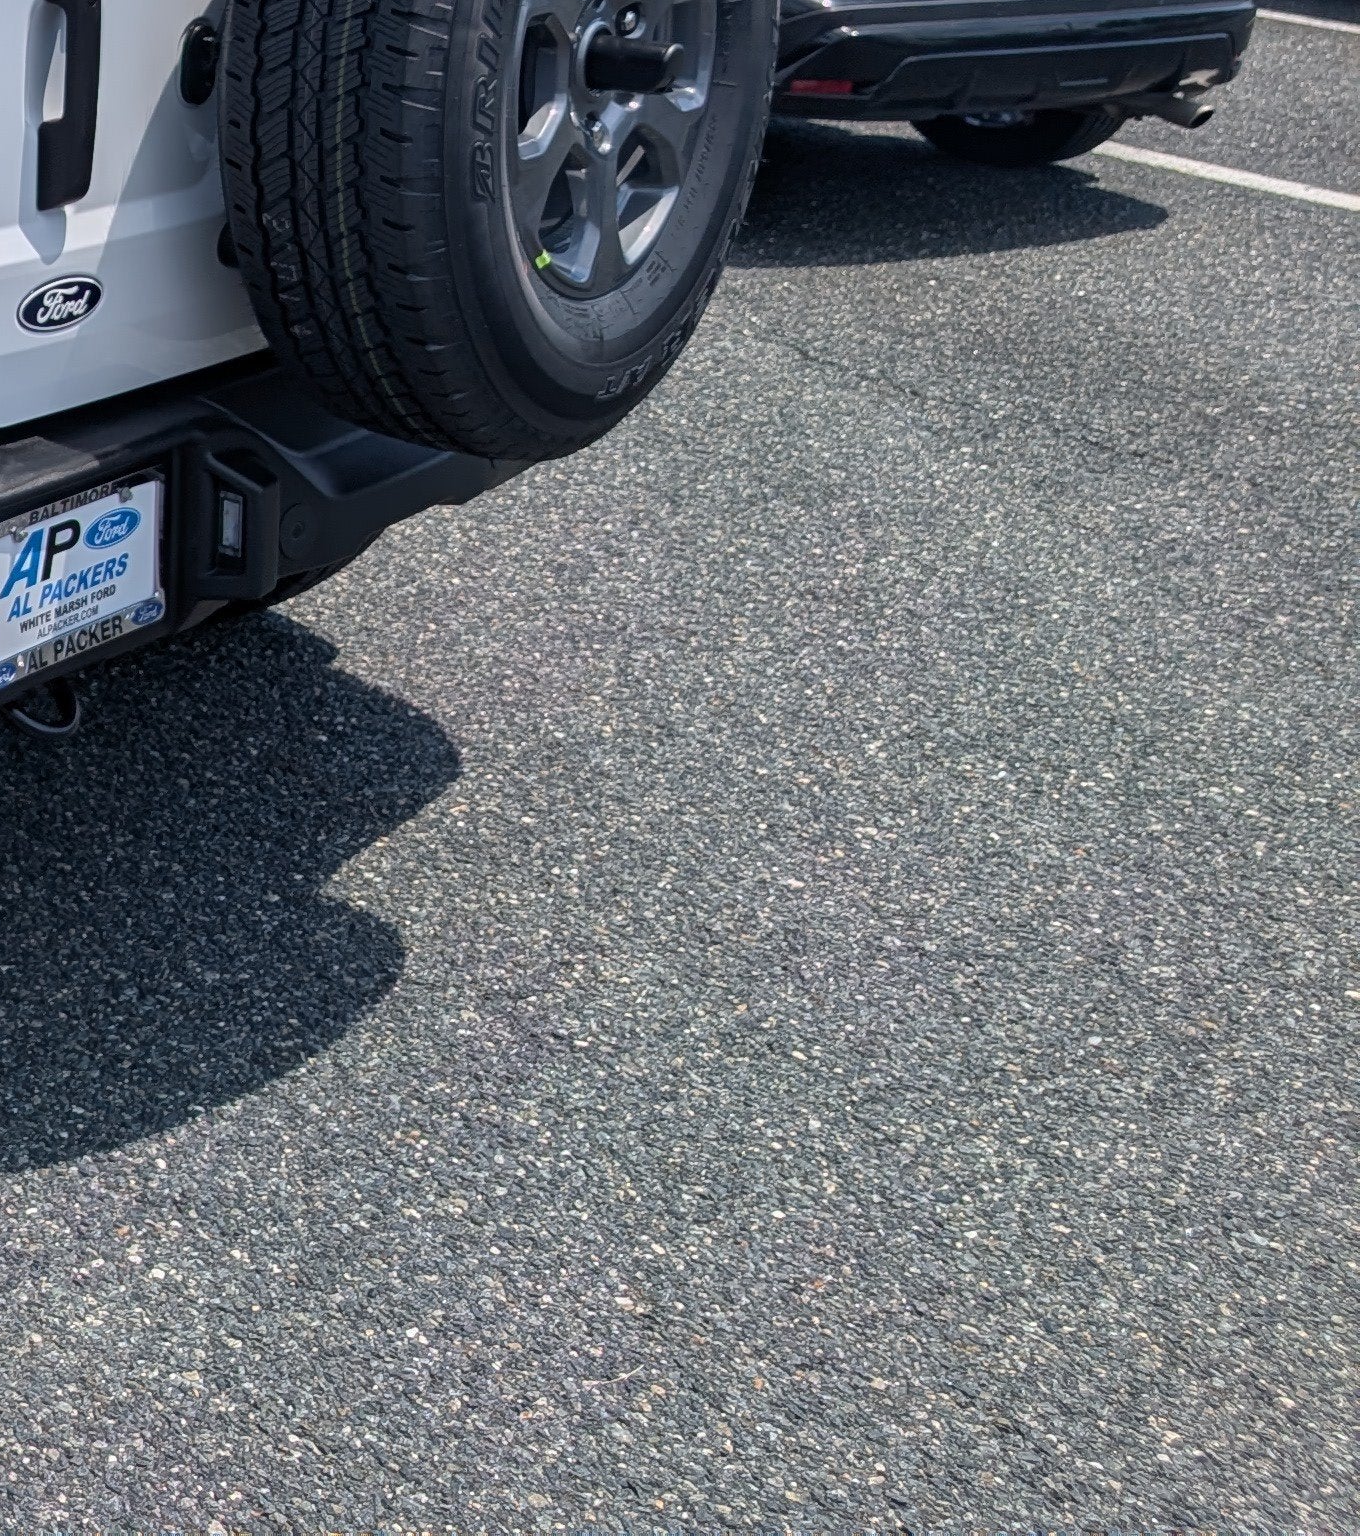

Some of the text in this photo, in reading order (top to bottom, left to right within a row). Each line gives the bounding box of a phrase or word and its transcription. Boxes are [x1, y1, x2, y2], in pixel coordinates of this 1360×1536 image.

[36, 285, 92, 324] Ford
[28, 481, 122, 523] BALTIMORE
[93, 513, 130, 546] Ford
[6, 551, 130, 622] AL PACKERS
[19, 584, 117, 634] WHITE MARSH FORD
[36, 604, 100, 640] ALPACKER.COM
[25, 614, 124, 673] AL PACKER
